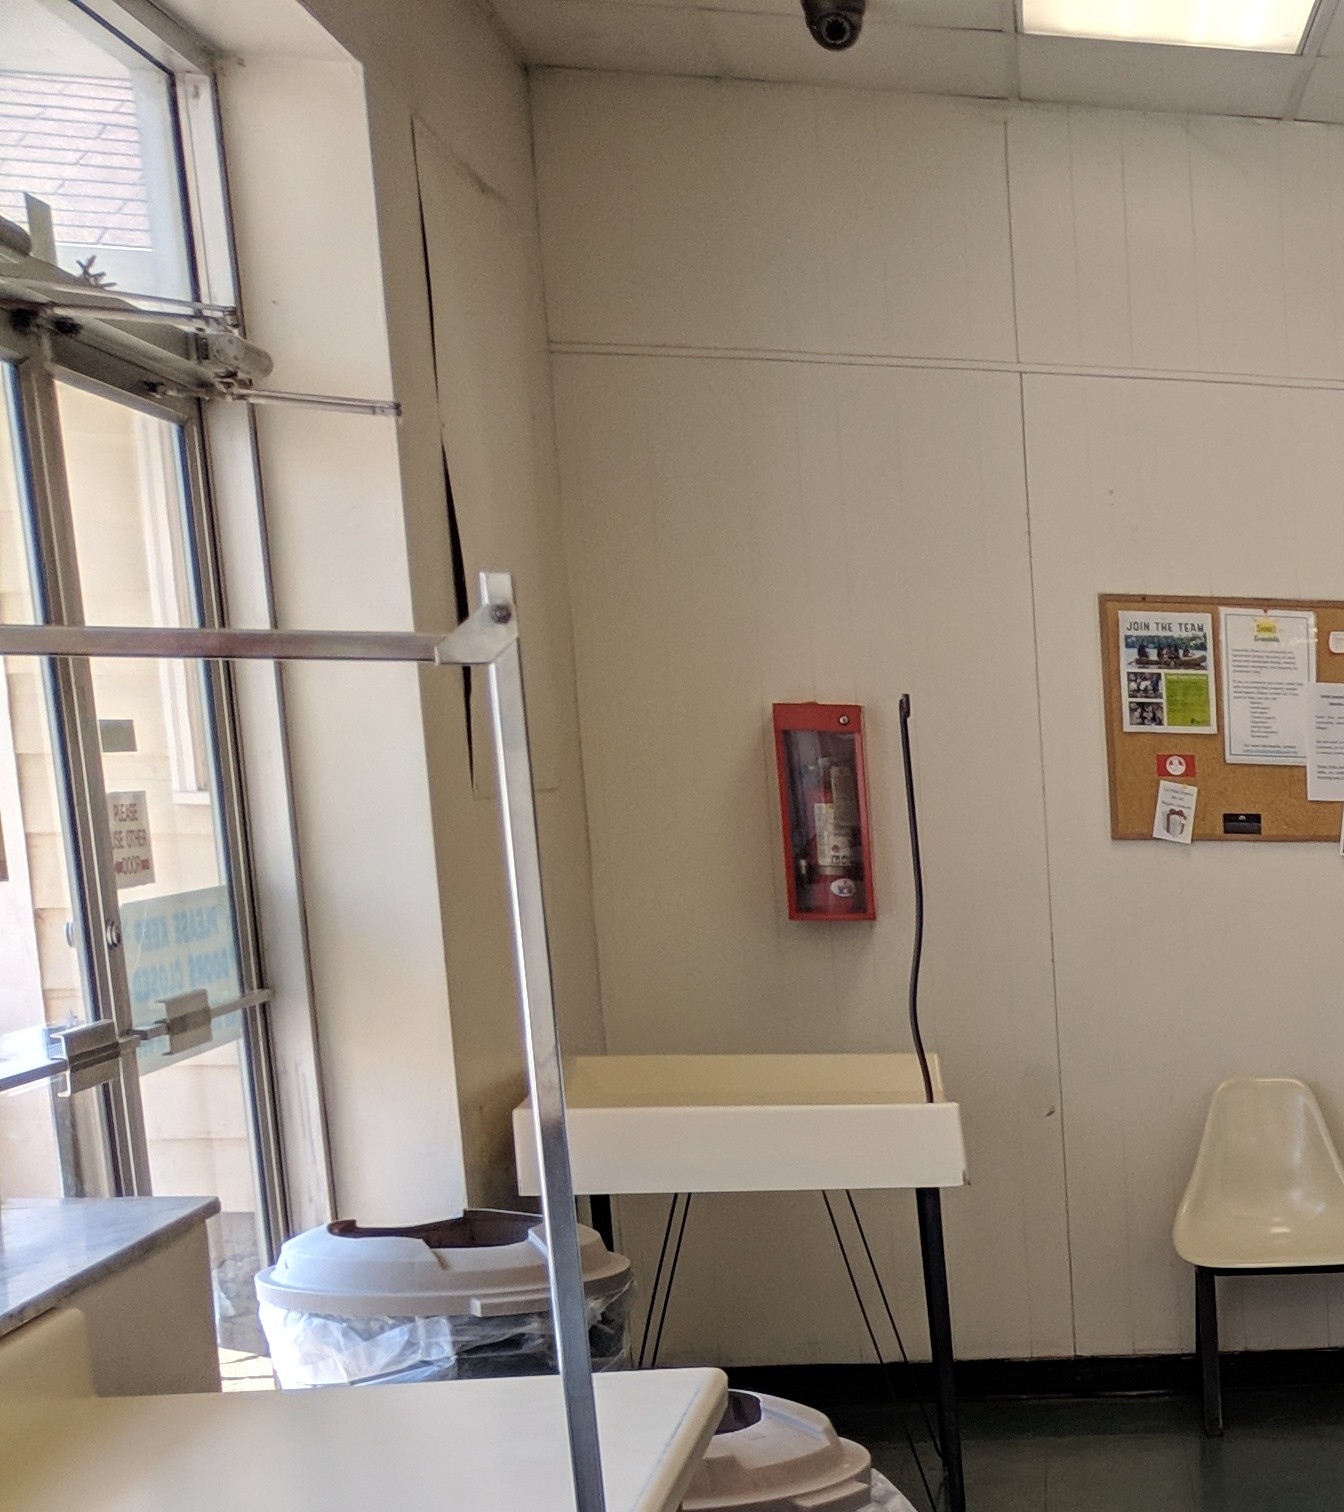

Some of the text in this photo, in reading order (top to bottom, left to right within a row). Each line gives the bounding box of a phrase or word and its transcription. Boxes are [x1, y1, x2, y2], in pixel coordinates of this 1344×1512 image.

[1126, 621, 1204, 633] JOIN THE TEAM
[113, 803, 138, 822] PLEASE
[112, 830, 124, 849] SE
